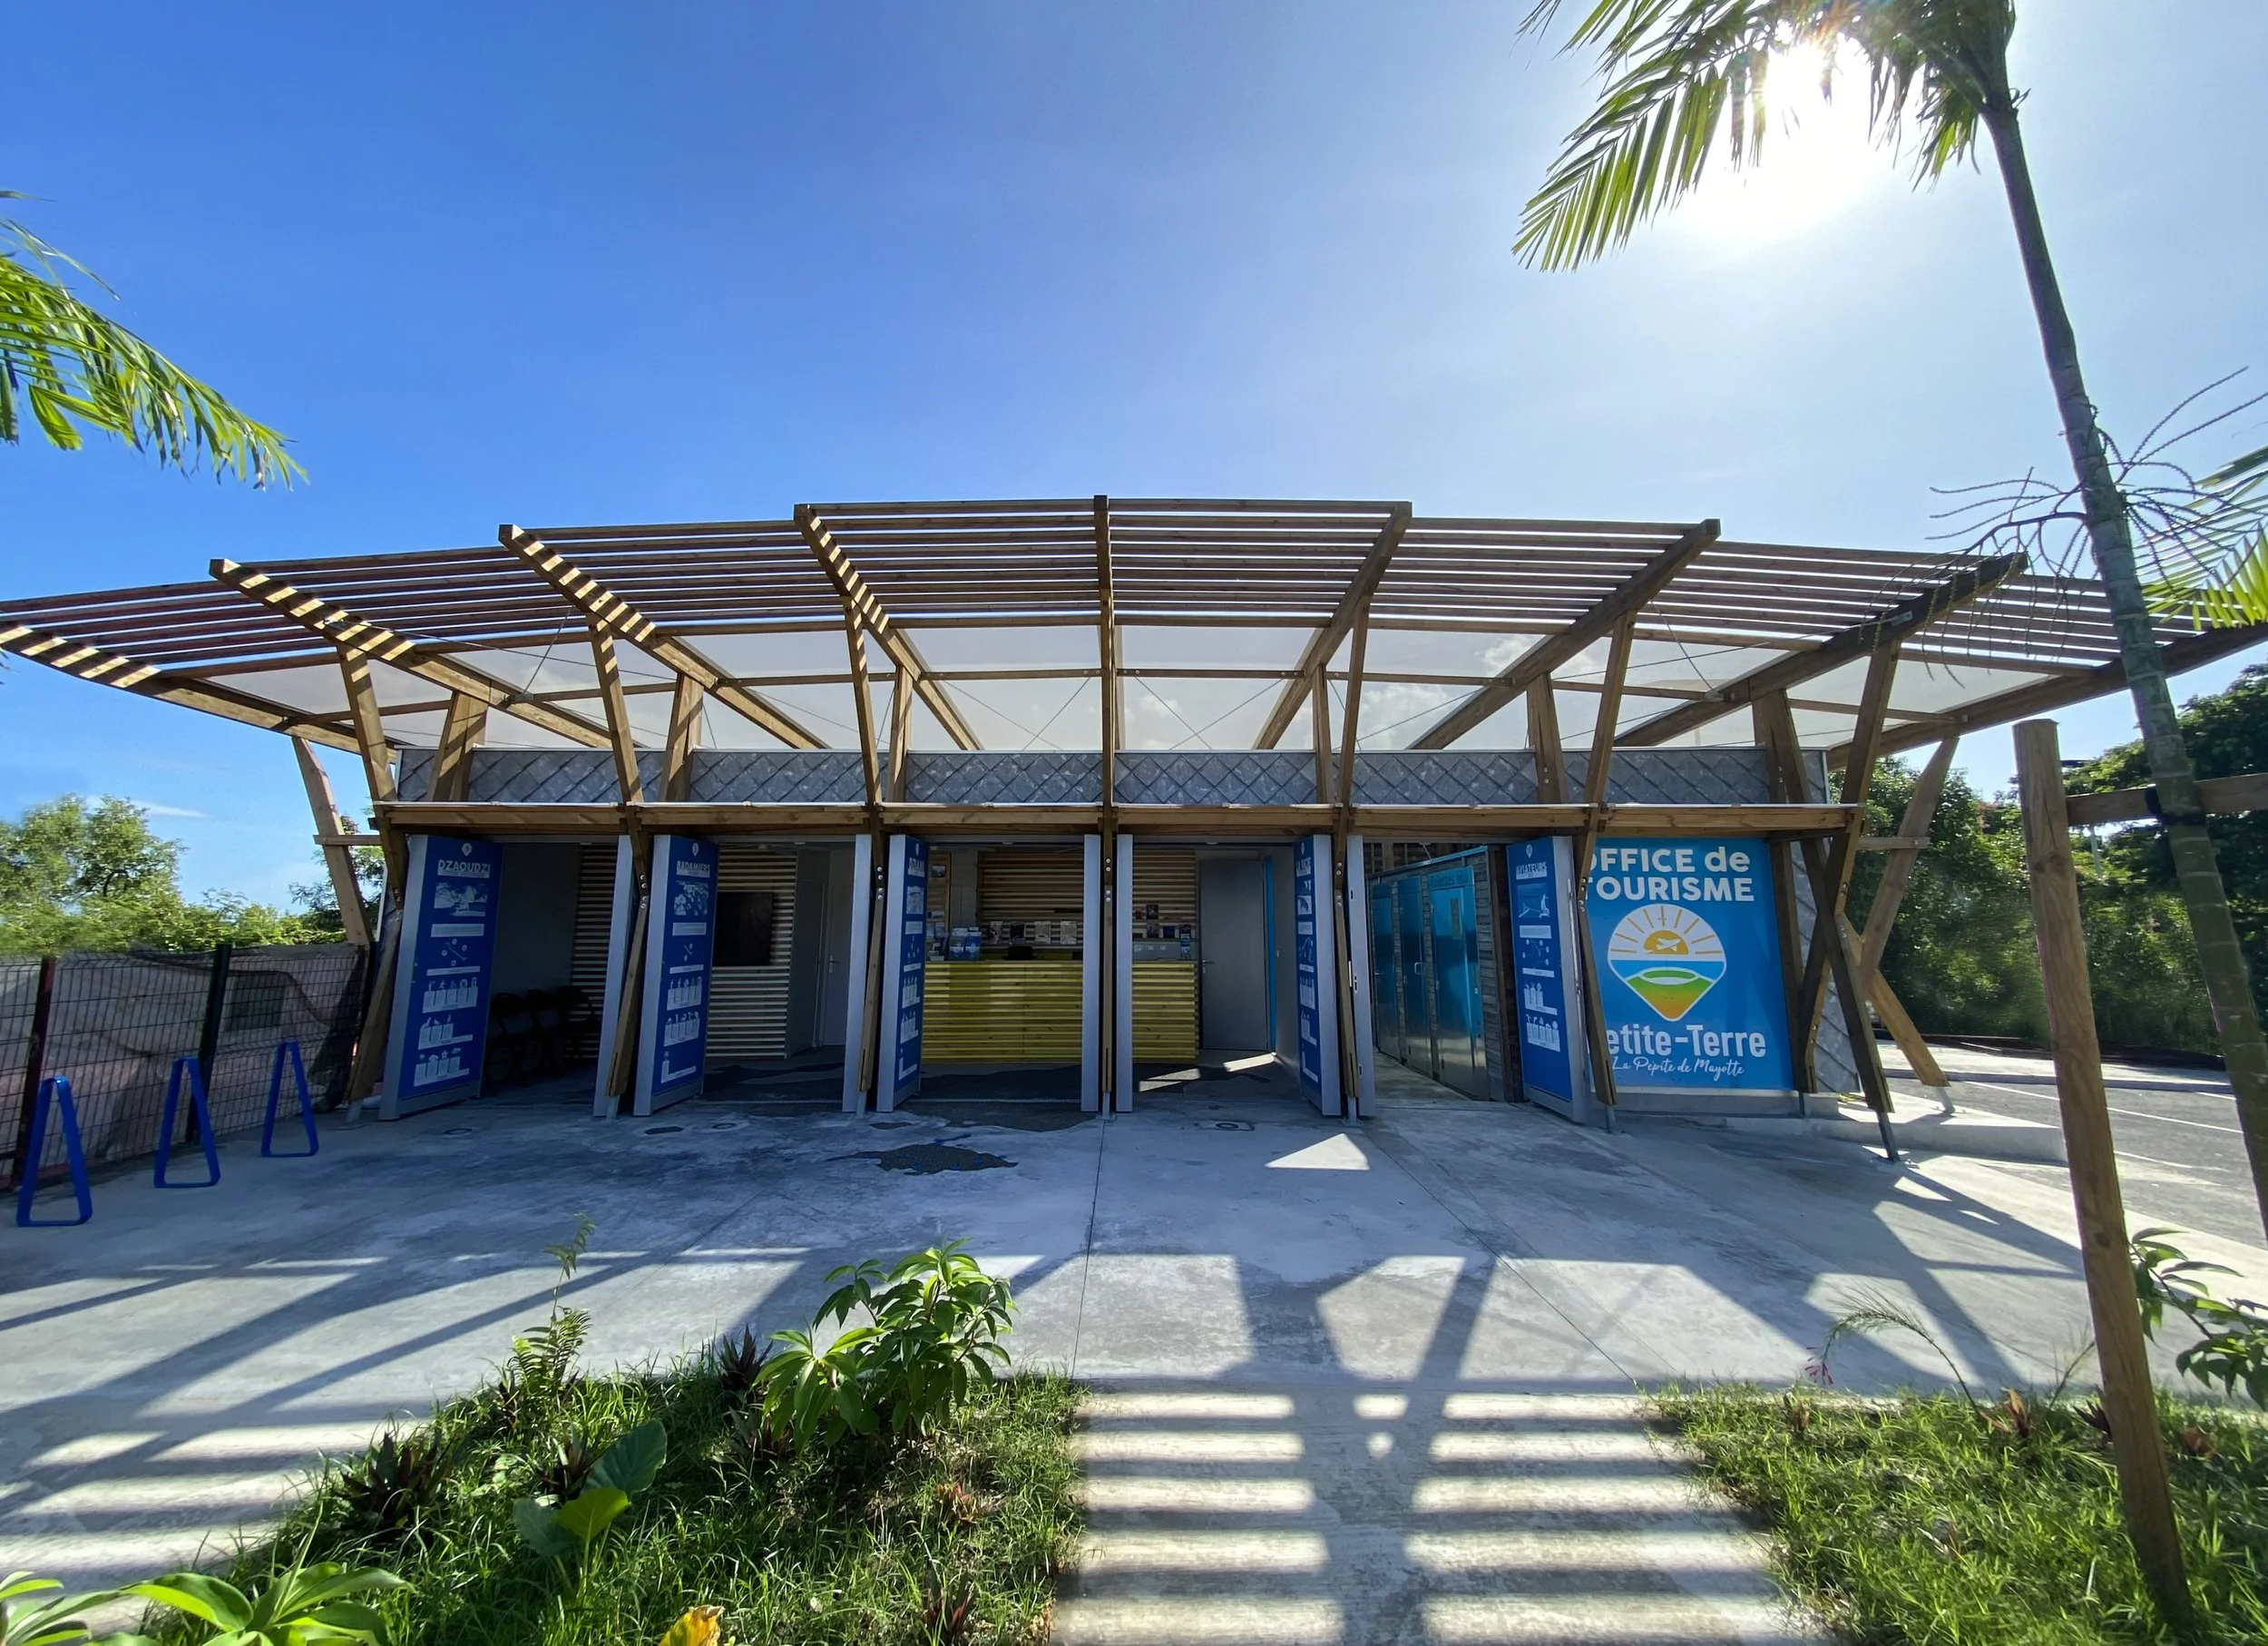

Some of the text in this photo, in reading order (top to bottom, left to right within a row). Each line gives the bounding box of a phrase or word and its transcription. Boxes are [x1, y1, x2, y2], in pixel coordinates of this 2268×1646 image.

[437, 859, 492, 873] DZAOUDZI
[1515, 861, 1547, 874] AVIATEURS
[1704, 847, 1751, 873] de
[1607, 1024, 1766, 1058] etite-Terre
[1633, 1056, 1676, 1076] Pépite
[1677, 1058, 1692, 1073] de
[1694, 1058, 1745, 1082] Mayotte
